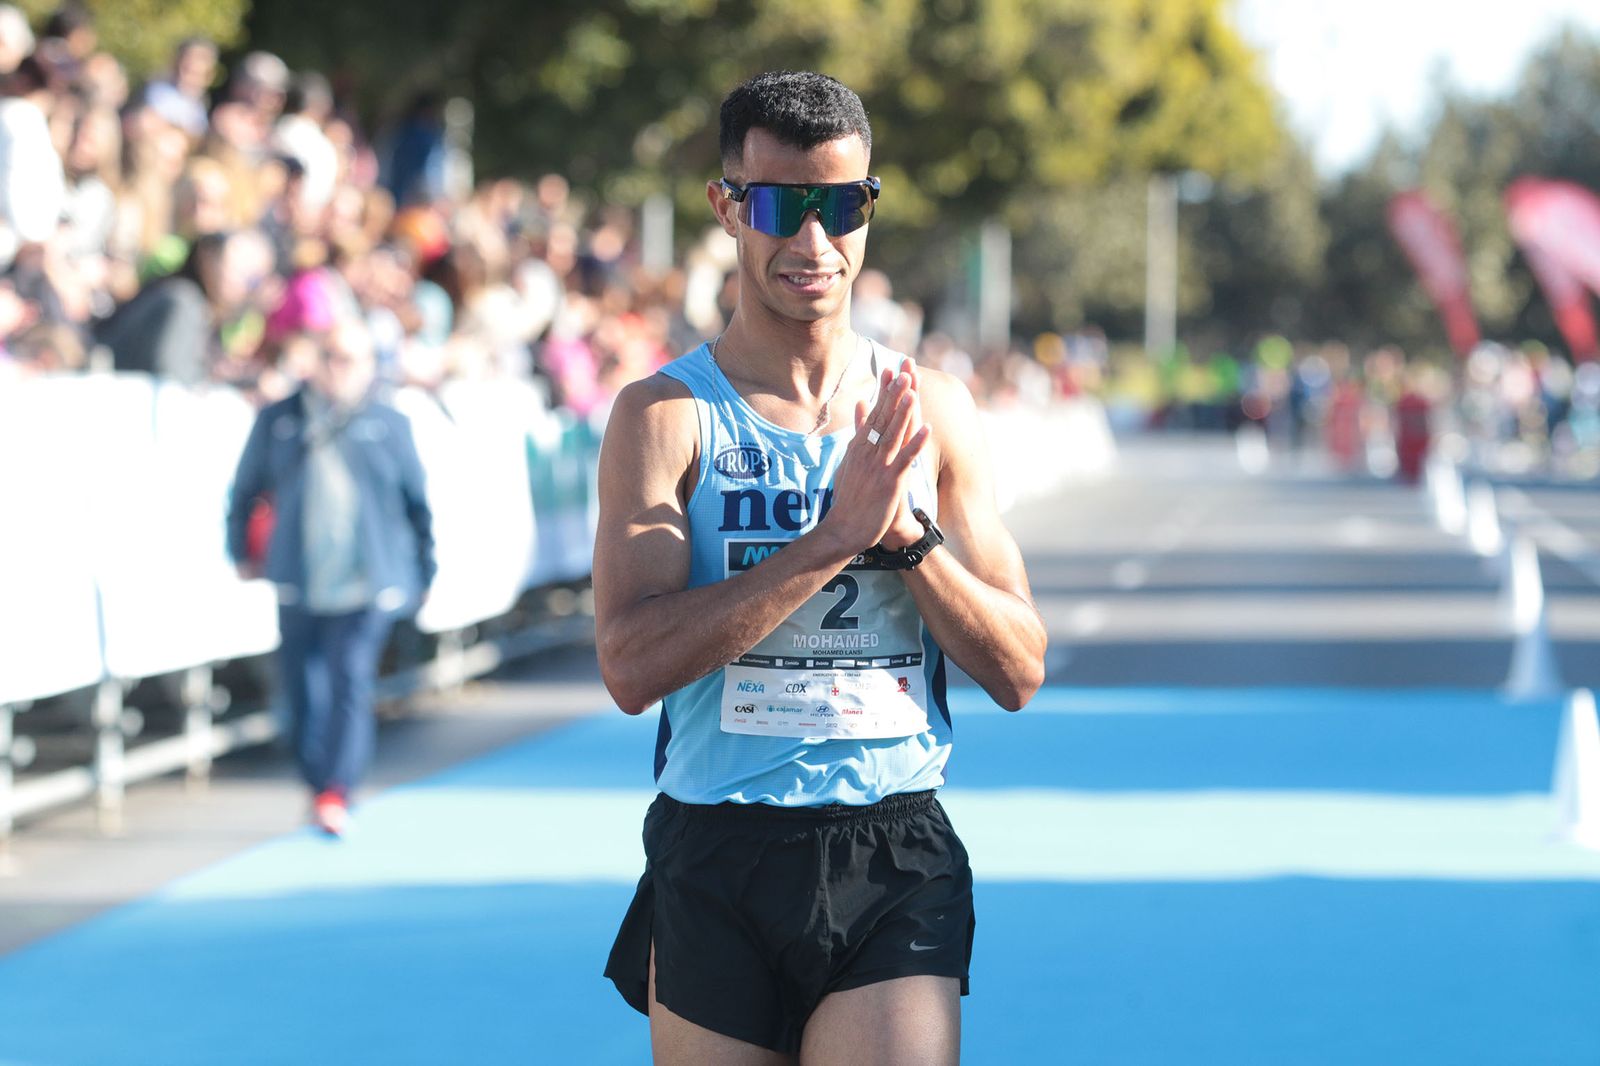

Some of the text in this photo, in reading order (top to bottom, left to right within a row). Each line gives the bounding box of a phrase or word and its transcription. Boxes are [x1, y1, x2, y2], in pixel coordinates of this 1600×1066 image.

[717, 450, 769, 473] TROPS
[819, 573, 860, 631] 2
[793, 633, 879, 649] MOHAMED
[736, 682, 807, 693] NEXA CDX
[734, 705, 755, 714] CASI
